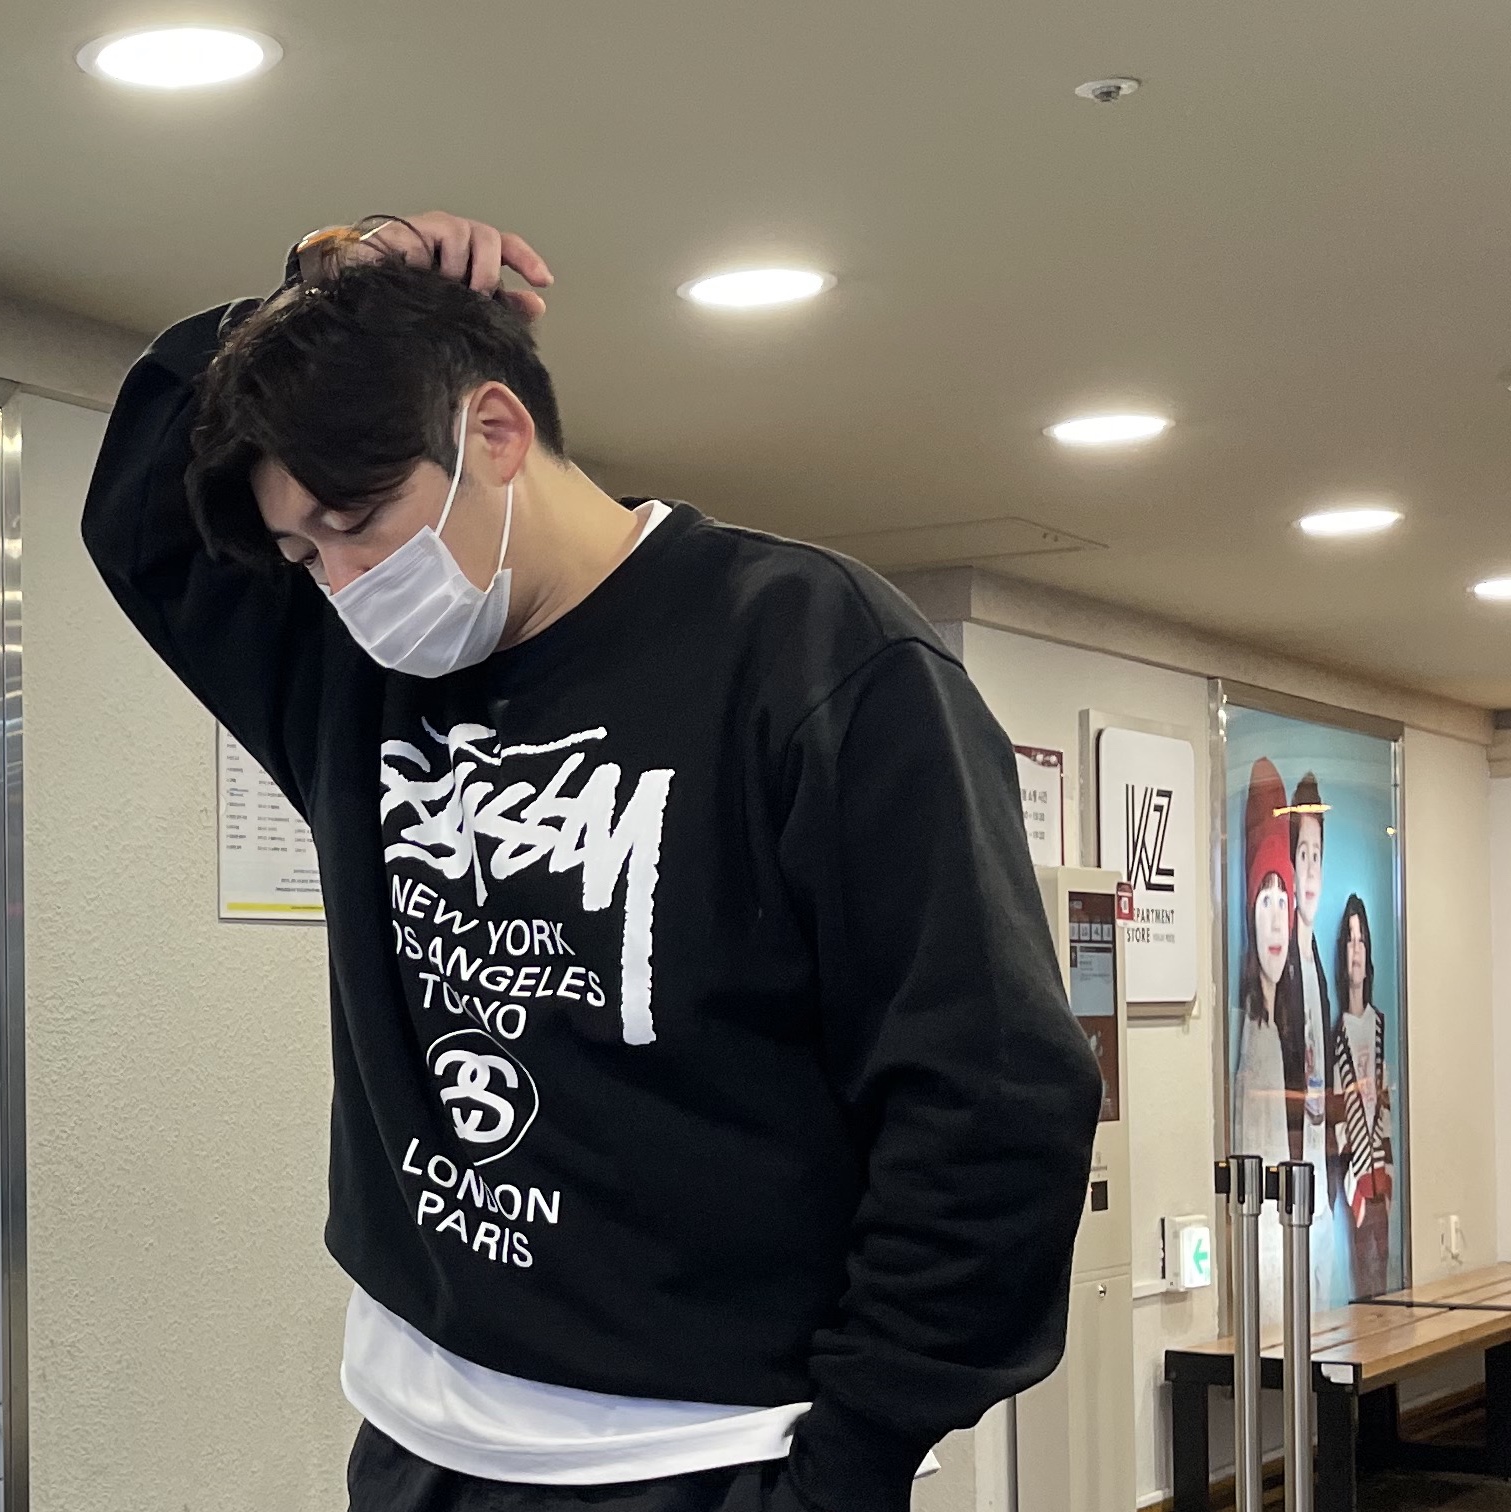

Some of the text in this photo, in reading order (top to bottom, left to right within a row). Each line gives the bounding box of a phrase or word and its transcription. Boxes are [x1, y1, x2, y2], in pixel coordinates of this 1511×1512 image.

[392, 874, 576, 956] NEW YORK
[1126, 927, 1150, 943] STORE
[1133, 908, 1175, 925] PARTMENT
[427, 936, 606, 1007] ANGELES
[417, 1190, 533, 1268] PARIS
